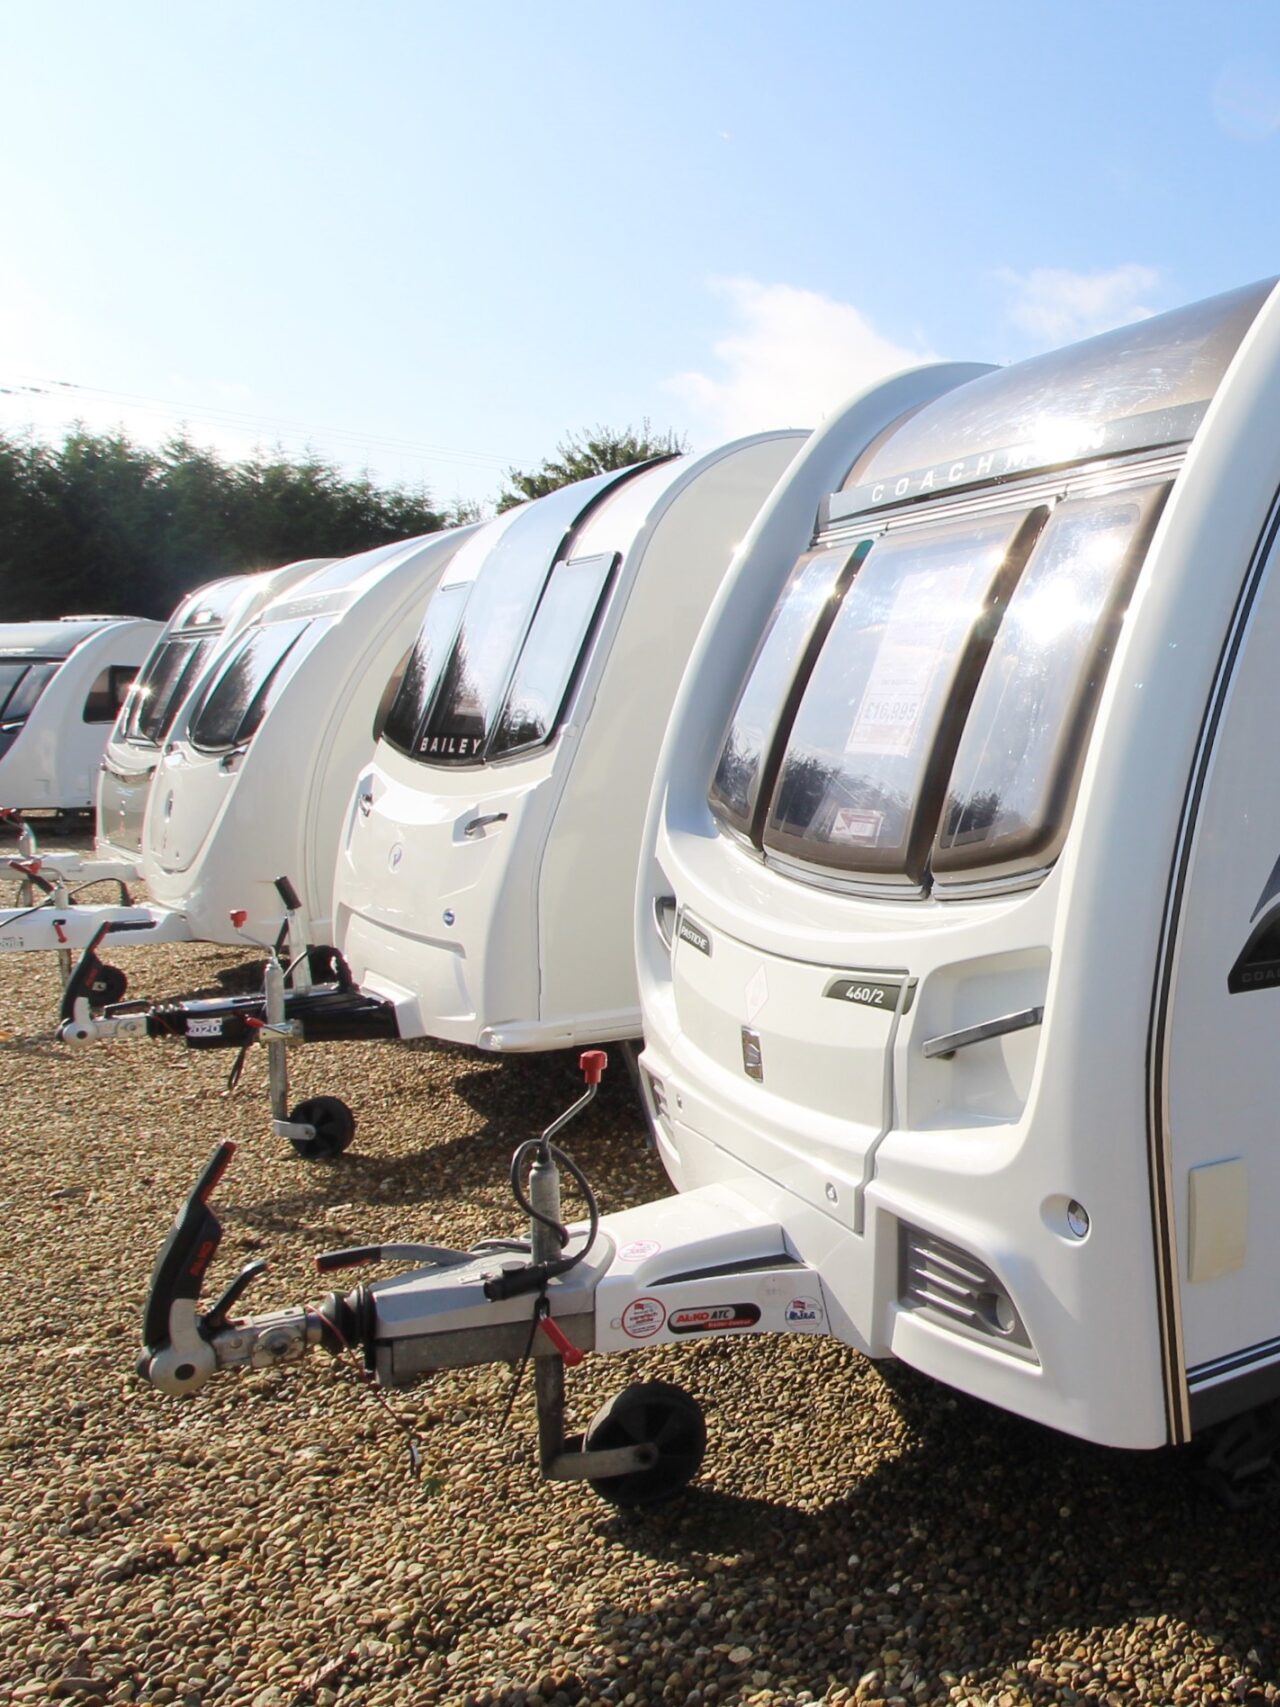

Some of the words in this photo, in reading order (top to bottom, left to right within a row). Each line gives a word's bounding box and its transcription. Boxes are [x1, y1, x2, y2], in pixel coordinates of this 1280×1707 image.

[420, 737, 482, 755] BAILEY
[681, 926, 709, 950] PASTICHE
[845, 985, 885, 1004] 460/2
[711, 1308, 731, 1320] ATC
